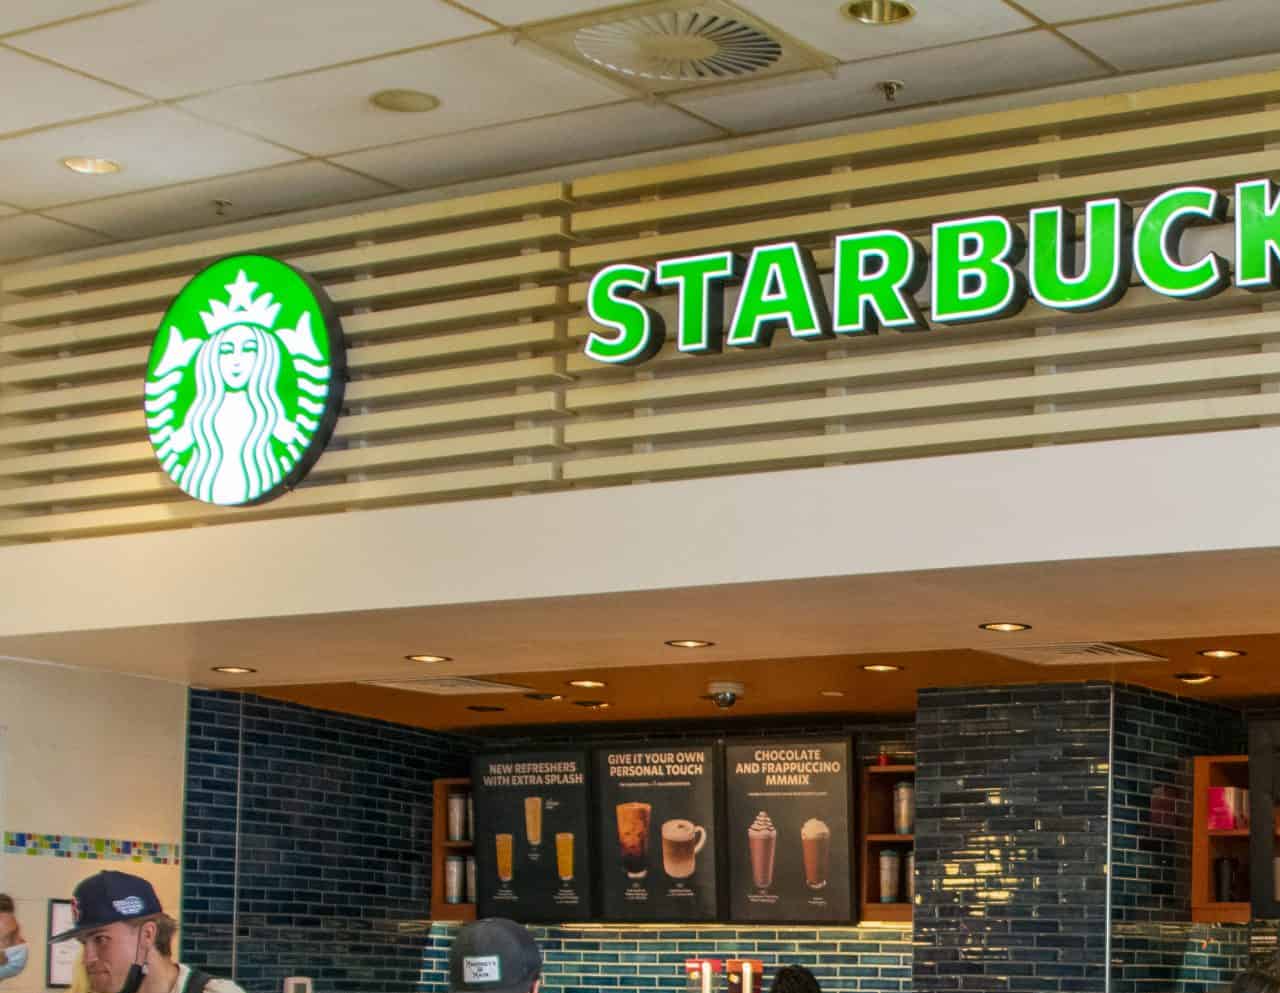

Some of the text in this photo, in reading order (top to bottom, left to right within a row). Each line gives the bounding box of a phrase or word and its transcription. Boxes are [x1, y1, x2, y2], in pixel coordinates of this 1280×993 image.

[607, 751, 705, 765] GIVE IT YOUR OWN
[754, 749, 822, 761] CHOCOLATE
[489, 762, 577, 775] NEW REFRESHERS
[609, 763, 703, 777] PERSONAL TOUCH
[735, 761, 840, 774] AND FRAPPUCCINO
[483, 773, 584, 786] WITH EXTRA SPLASH
[766, 775, 810, 786] MMMIX
